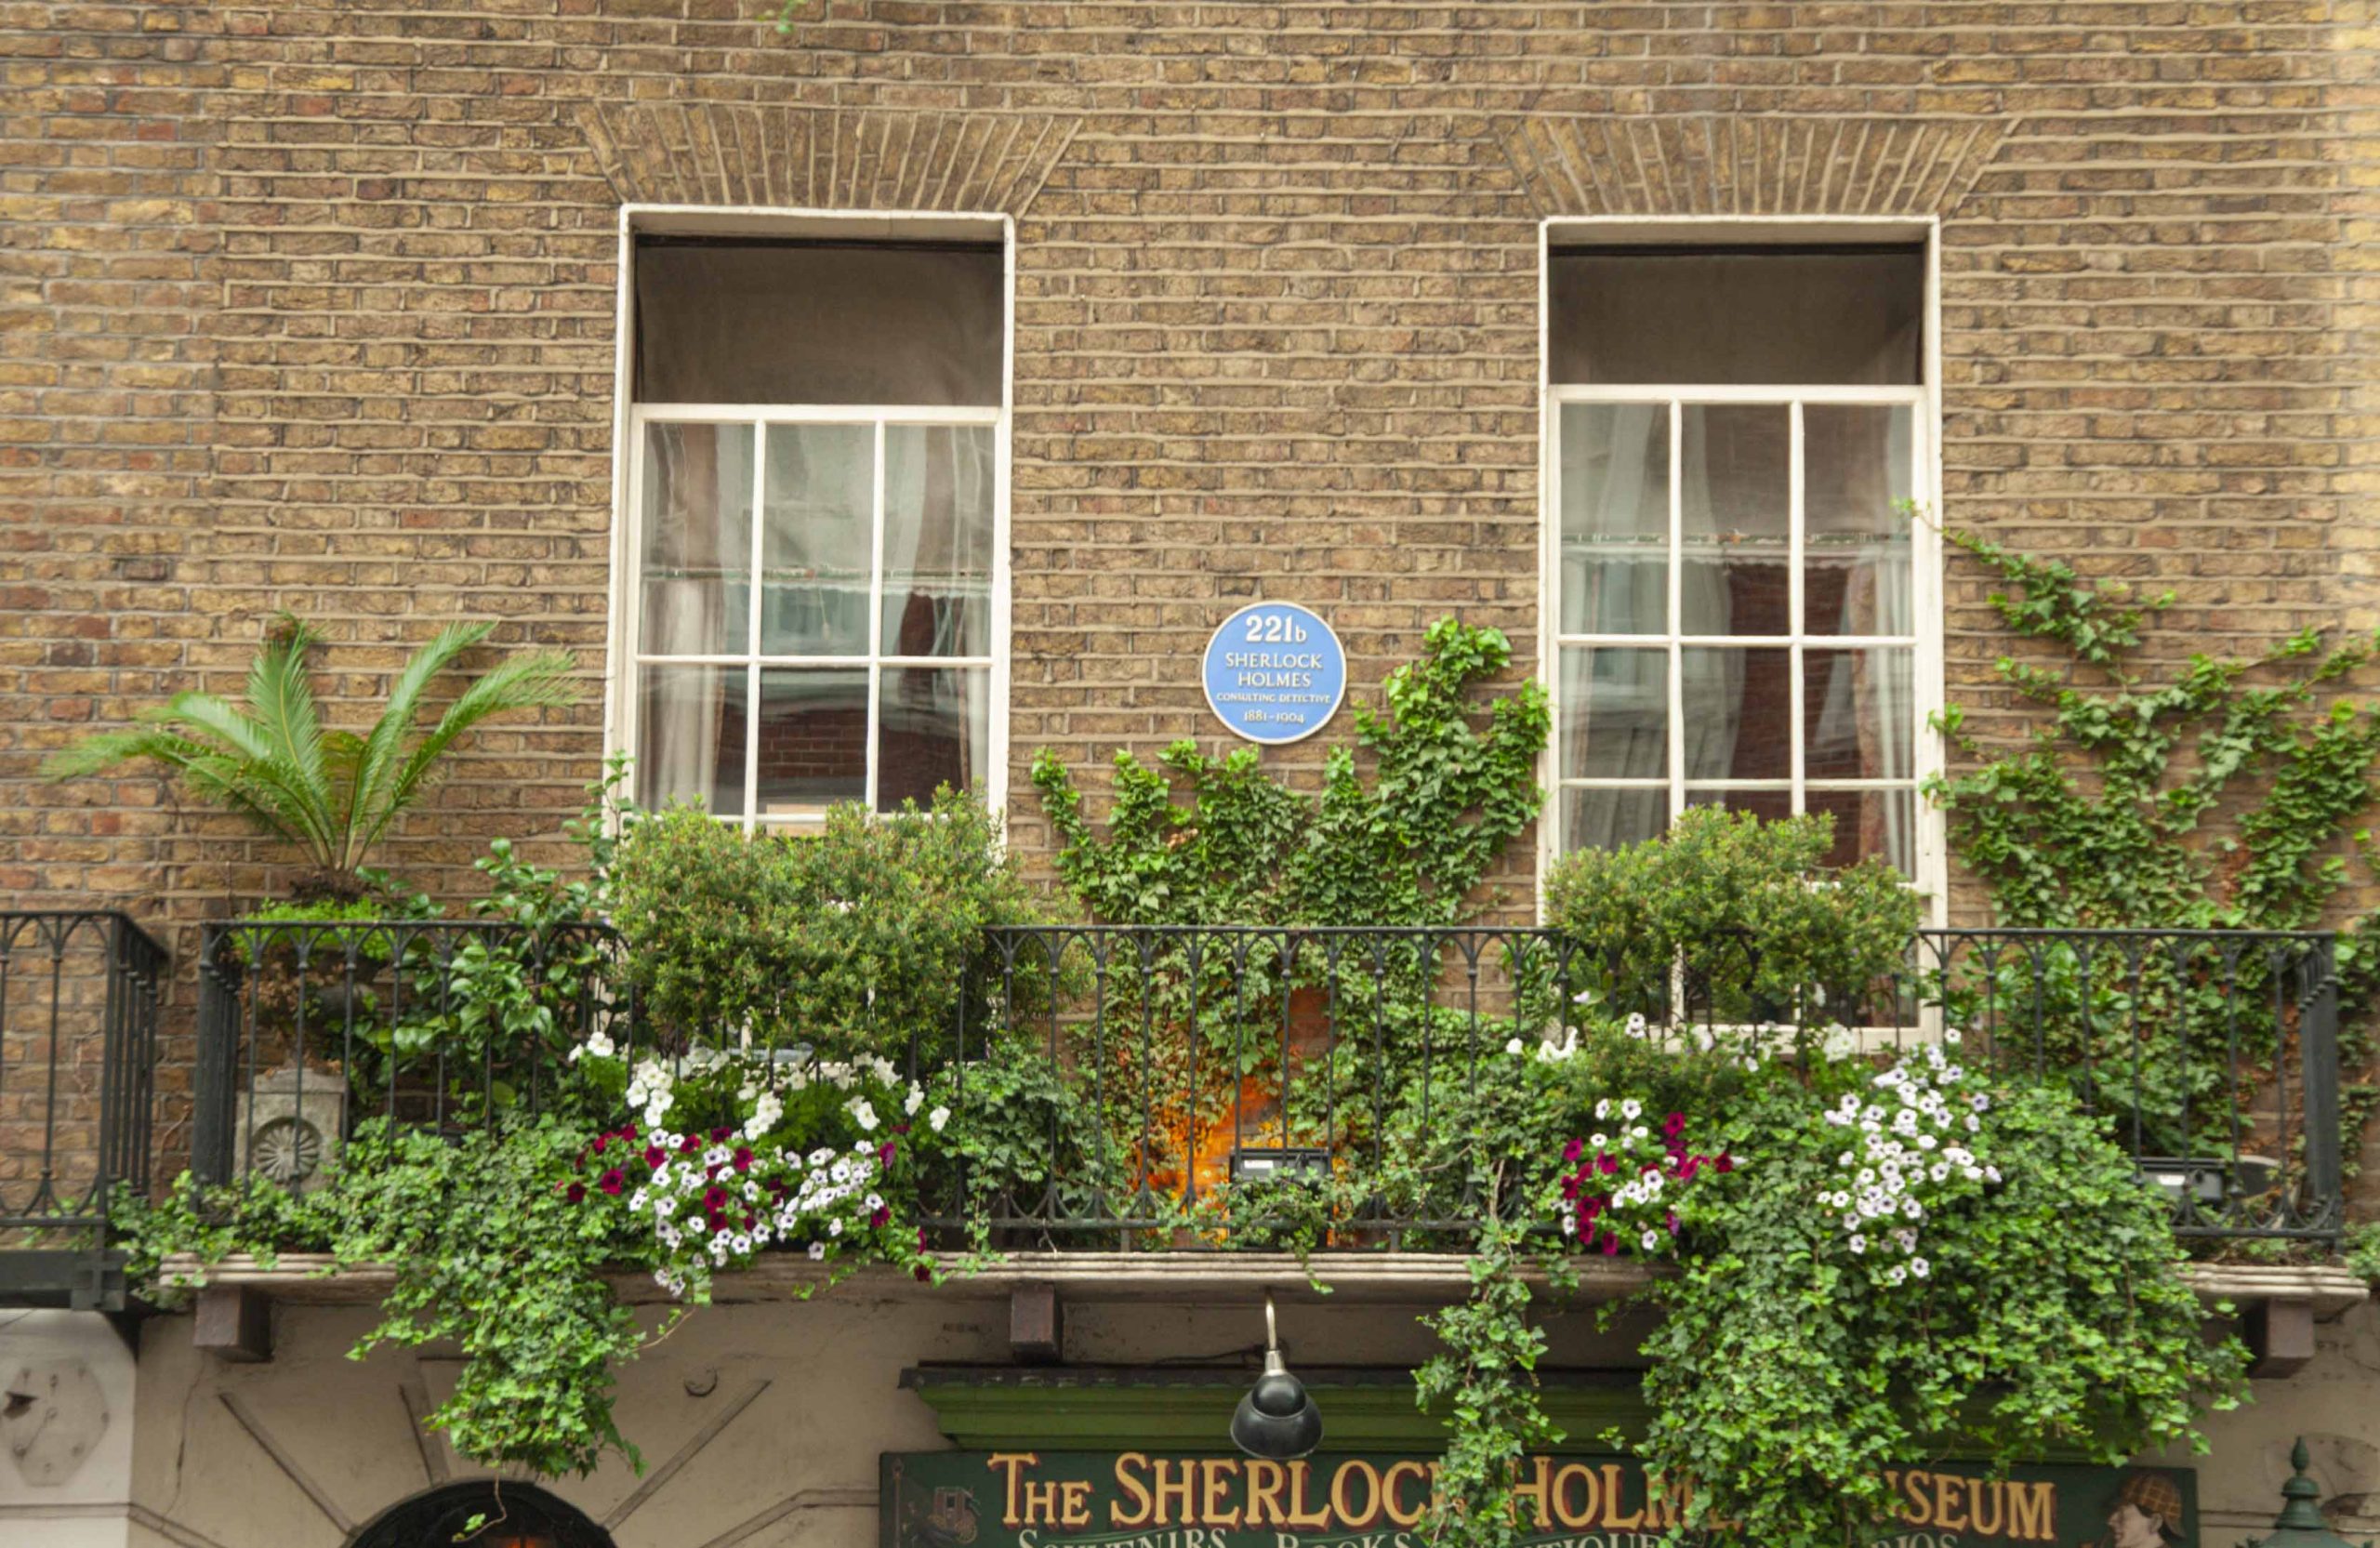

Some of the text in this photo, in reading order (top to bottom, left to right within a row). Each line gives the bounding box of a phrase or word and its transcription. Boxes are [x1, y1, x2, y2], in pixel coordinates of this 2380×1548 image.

[1245, 615, 1307, 642] 221b
[1225, 653, 1323, 668] SHERLOCK
[1237, 671, 1312, 687] HOLMES
[1216, 692, 1331, 704] CONSULTING DETECTIVE
[1503, 1455, 1743, 1531] HOLM
[1867, 1469, 2056, 1541] SEUM
